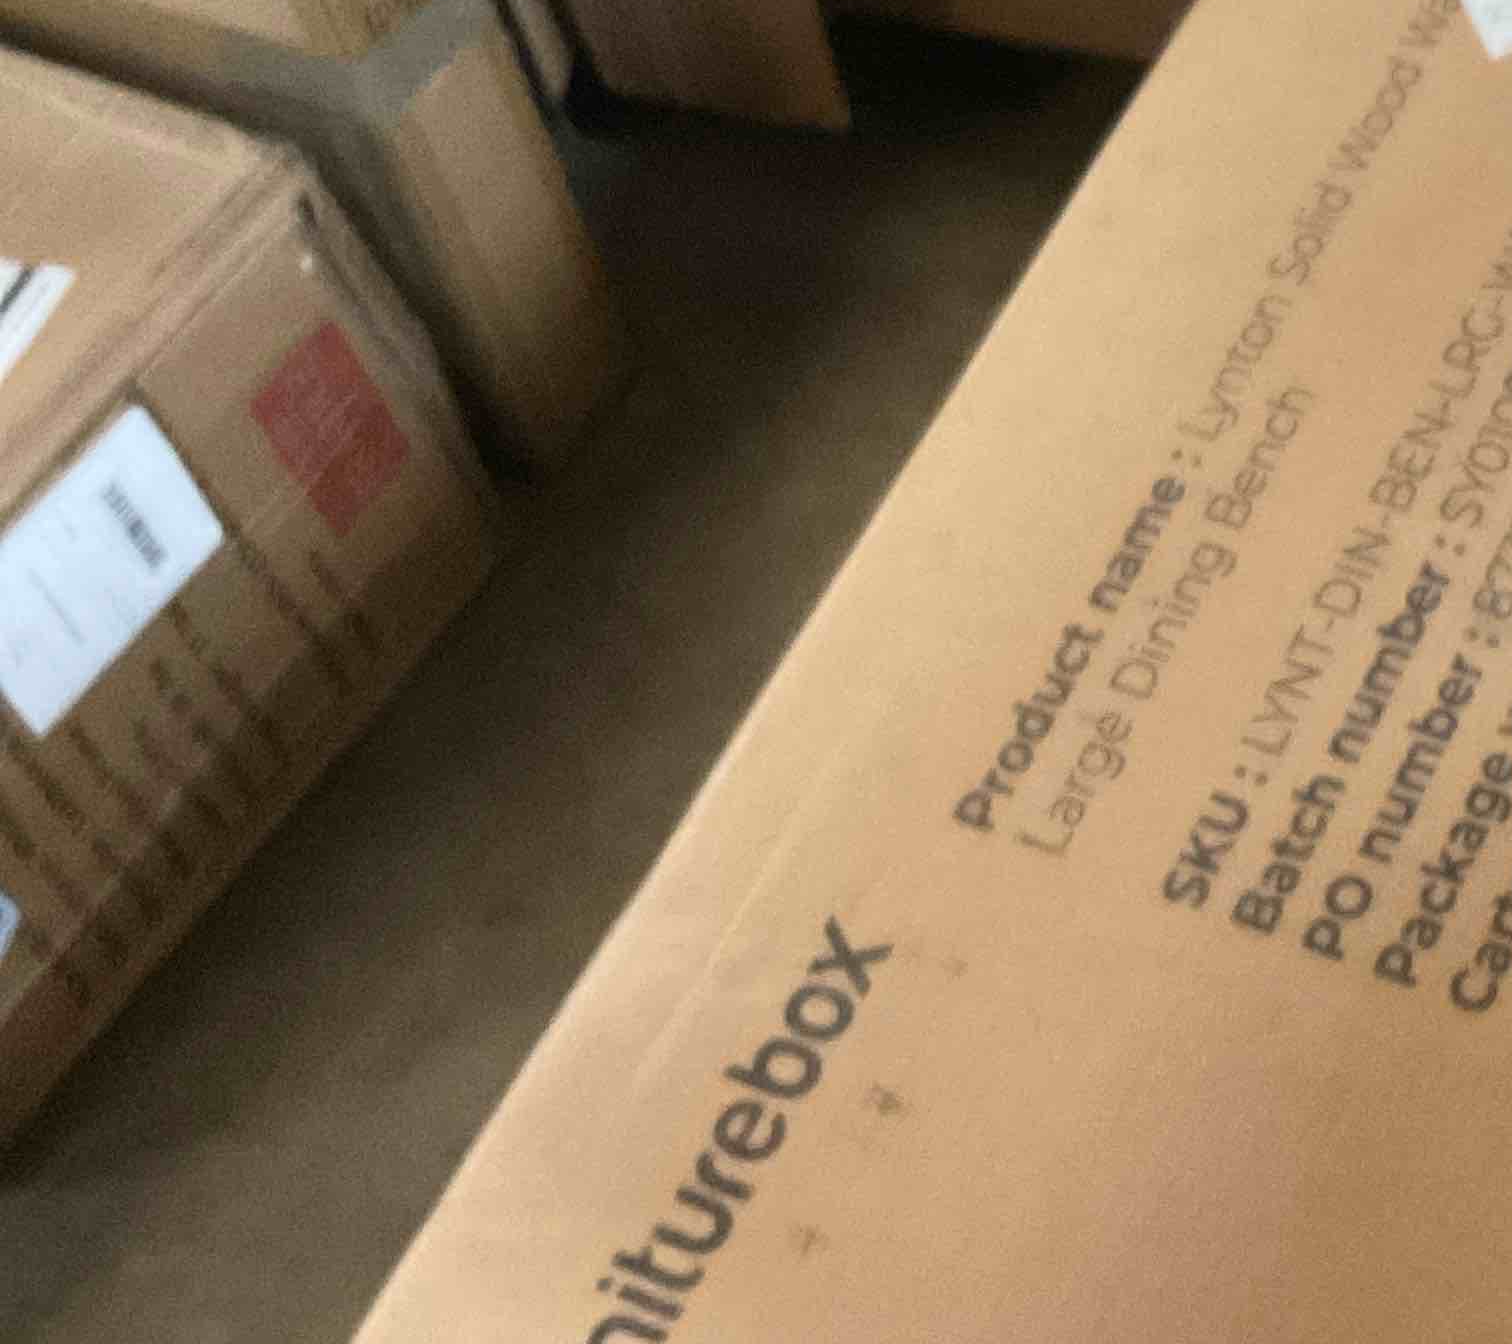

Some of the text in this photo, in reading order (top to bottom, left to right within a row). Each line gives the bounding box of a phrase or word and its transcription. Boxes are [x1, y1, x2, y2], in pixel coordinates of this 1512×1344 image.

[952, 622, 1102, 832] Product
[1087, 477, 1186, 610] name
[1180, 295, 1299, 440] Lynton
[1265, 183, 1353, 284] Solid
[1330, 60, 1423, 175] Wood
[1017, 386, 1315, 859] Large Dining Bench
[1161, 792, 1255, 910] SKU
[1232, 771, 1347, 933] Batch
[1319, 561, 1453, 763] number
[1302, 871, 1377, 960] PO
[1350, 653, 1486, 863] number
